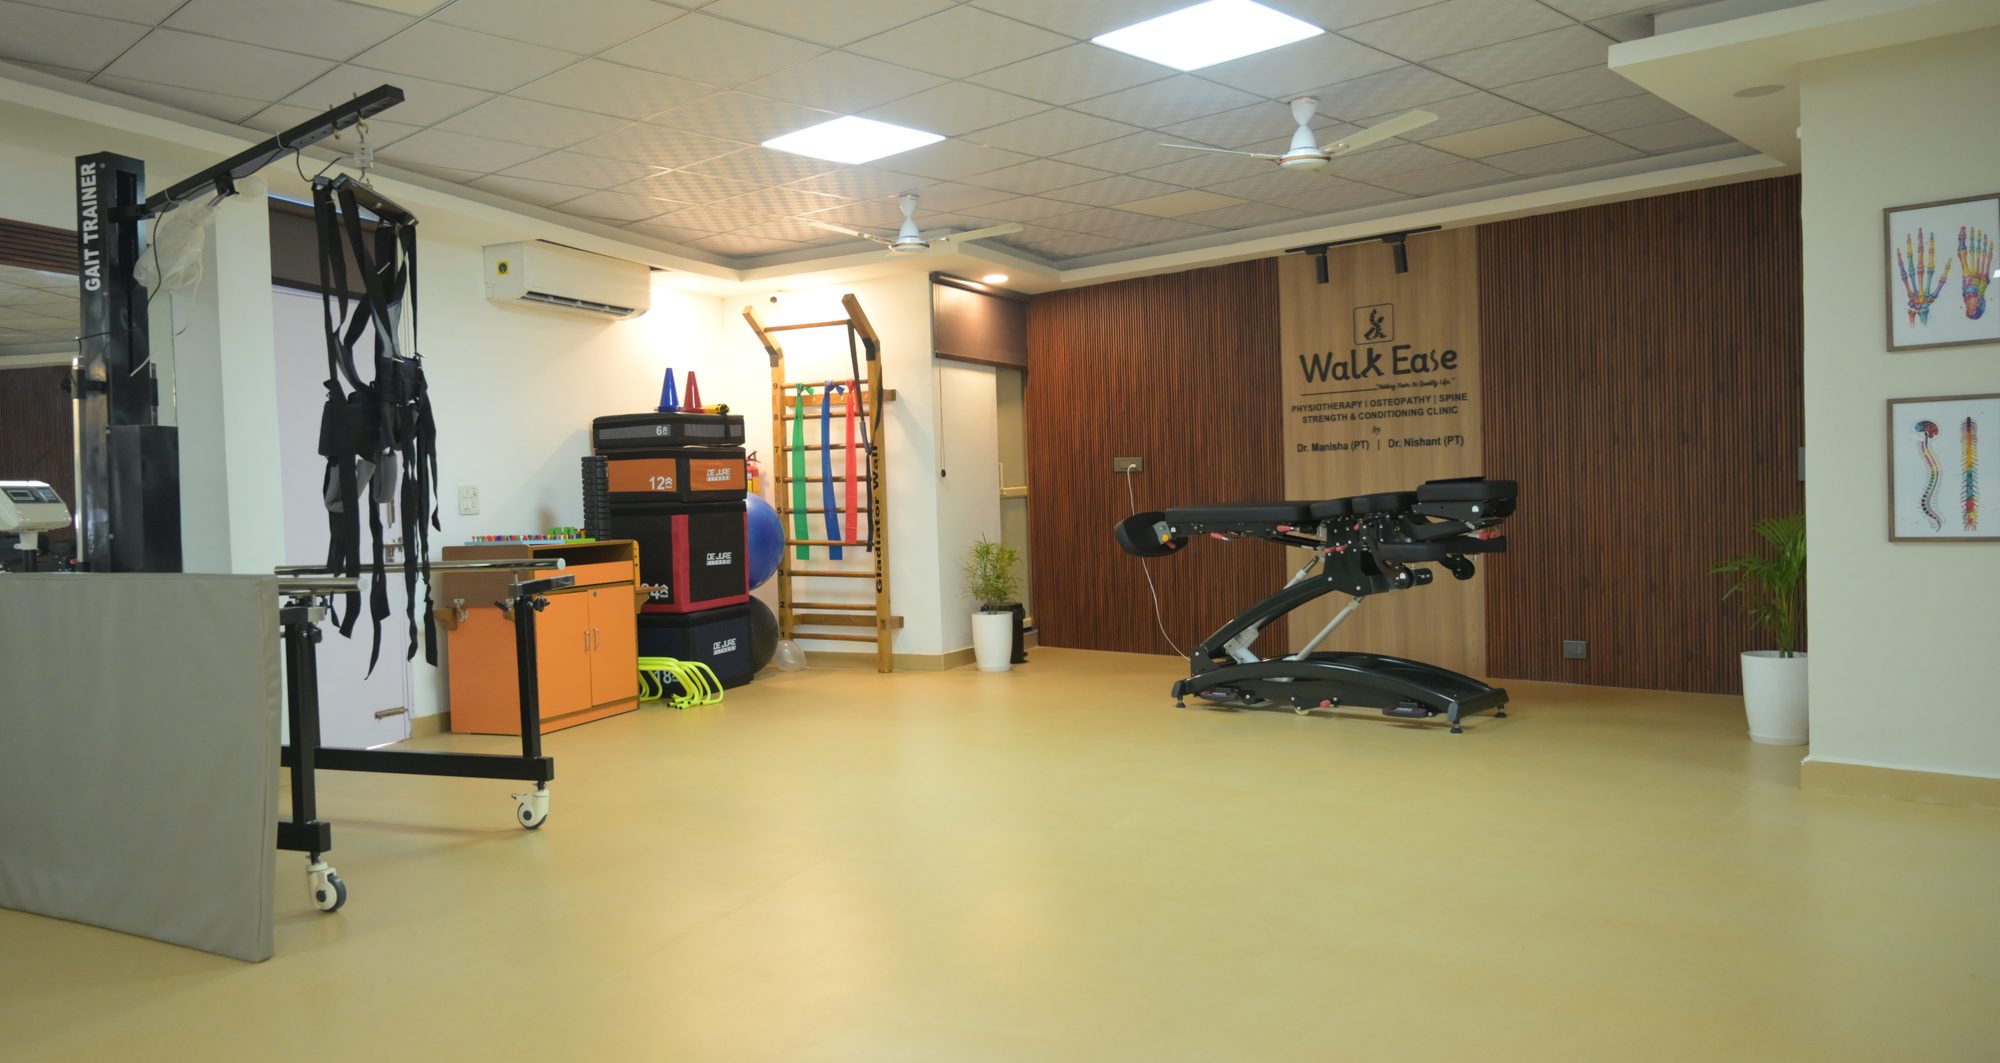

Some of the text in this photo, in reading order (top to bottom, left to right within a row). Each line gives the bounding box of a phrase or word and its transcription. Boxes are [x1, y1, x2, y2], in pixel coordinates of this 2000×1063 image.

[80, 161, 100, 292] GAIT TRAINER
[1299, 344, 1457, 383] Walk Ease
[1291, 401, 1363, 414] PHYSIOTHERAPY
[1370, 396, 1431, 408] OSTEOPATHY
[1439, 393, 1468, 403] SPINE
[1302, 413, 1348, 424] STRENGTH
[1358, 409, 1424, 420] CONDITIONING
[1427, 406, 1459, 416] CLINIC
[656, 426, 662, 436] 6
[1372, 425, 1380, 435] by
[1297, 444, 1309, 452] Dr.
[1311, 441, 1348, 452] Manisha
[1351, 440, 1370, 451] (PT)
[1388, 439, 1402, 449] Dr.
[1404, 436, 1441, 448] Nishant
[1443, 435, 1464, 447] (PT)
[707, 468, 731, 477] DE JURE
[649, 476, 665, 490] 12
[872, 446, 883, 593] Gladiator Wall
[716, 552, 732, 560] JURE
[713, 641, 721, 650] DE
[721, 638, 736, 648] JURE
